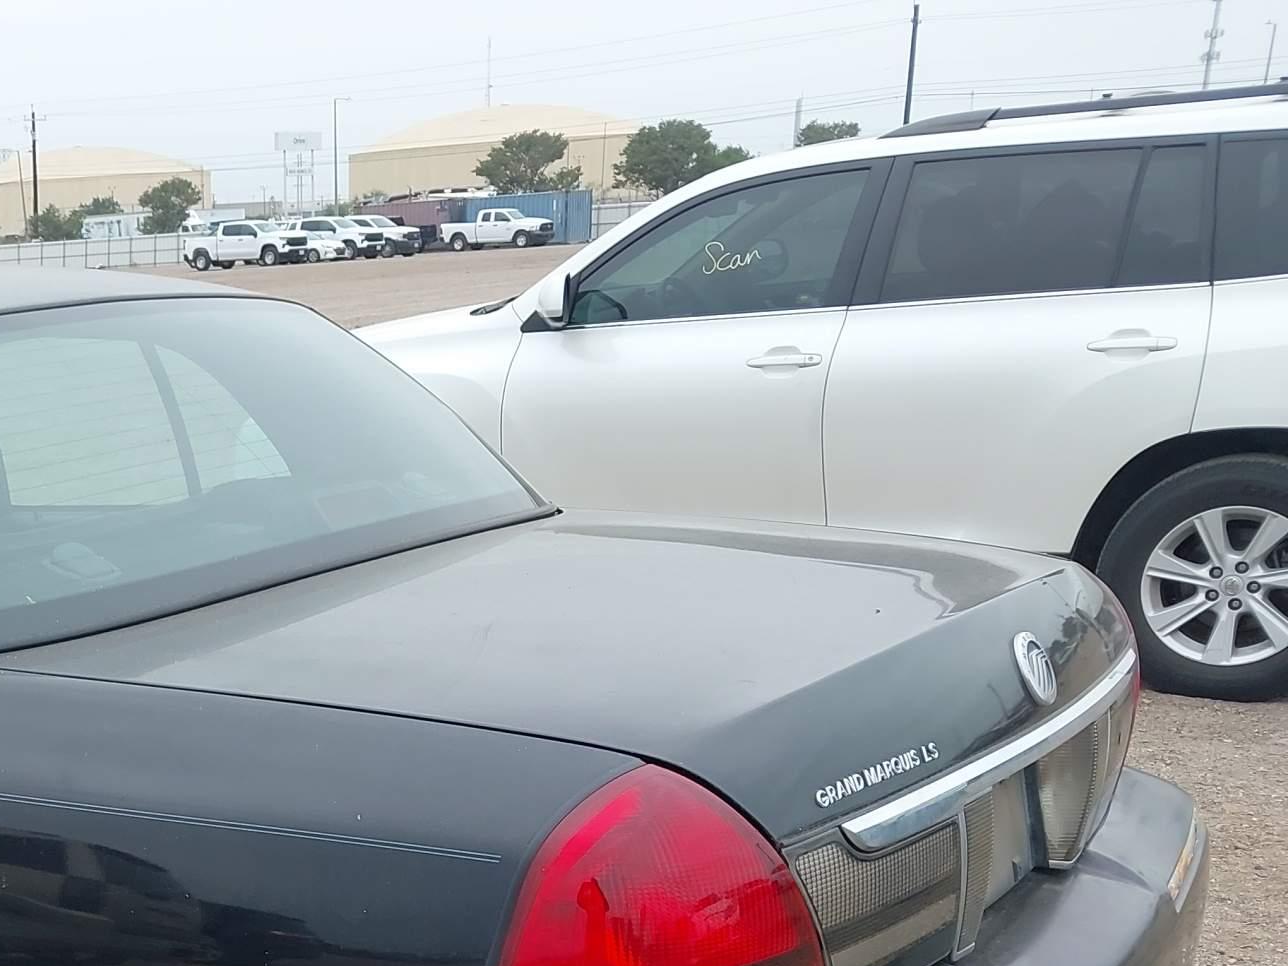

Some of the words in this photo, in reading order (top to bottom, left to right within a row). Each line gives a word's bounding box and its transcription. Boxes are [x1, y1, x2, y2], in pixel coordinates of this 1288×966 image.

[702, 241, 763, 275] Scan
[815, 773, 865, 807] GRAND
[863, 749, 921, 787] MARQUIS
[921, 742, 939, 763] LS
